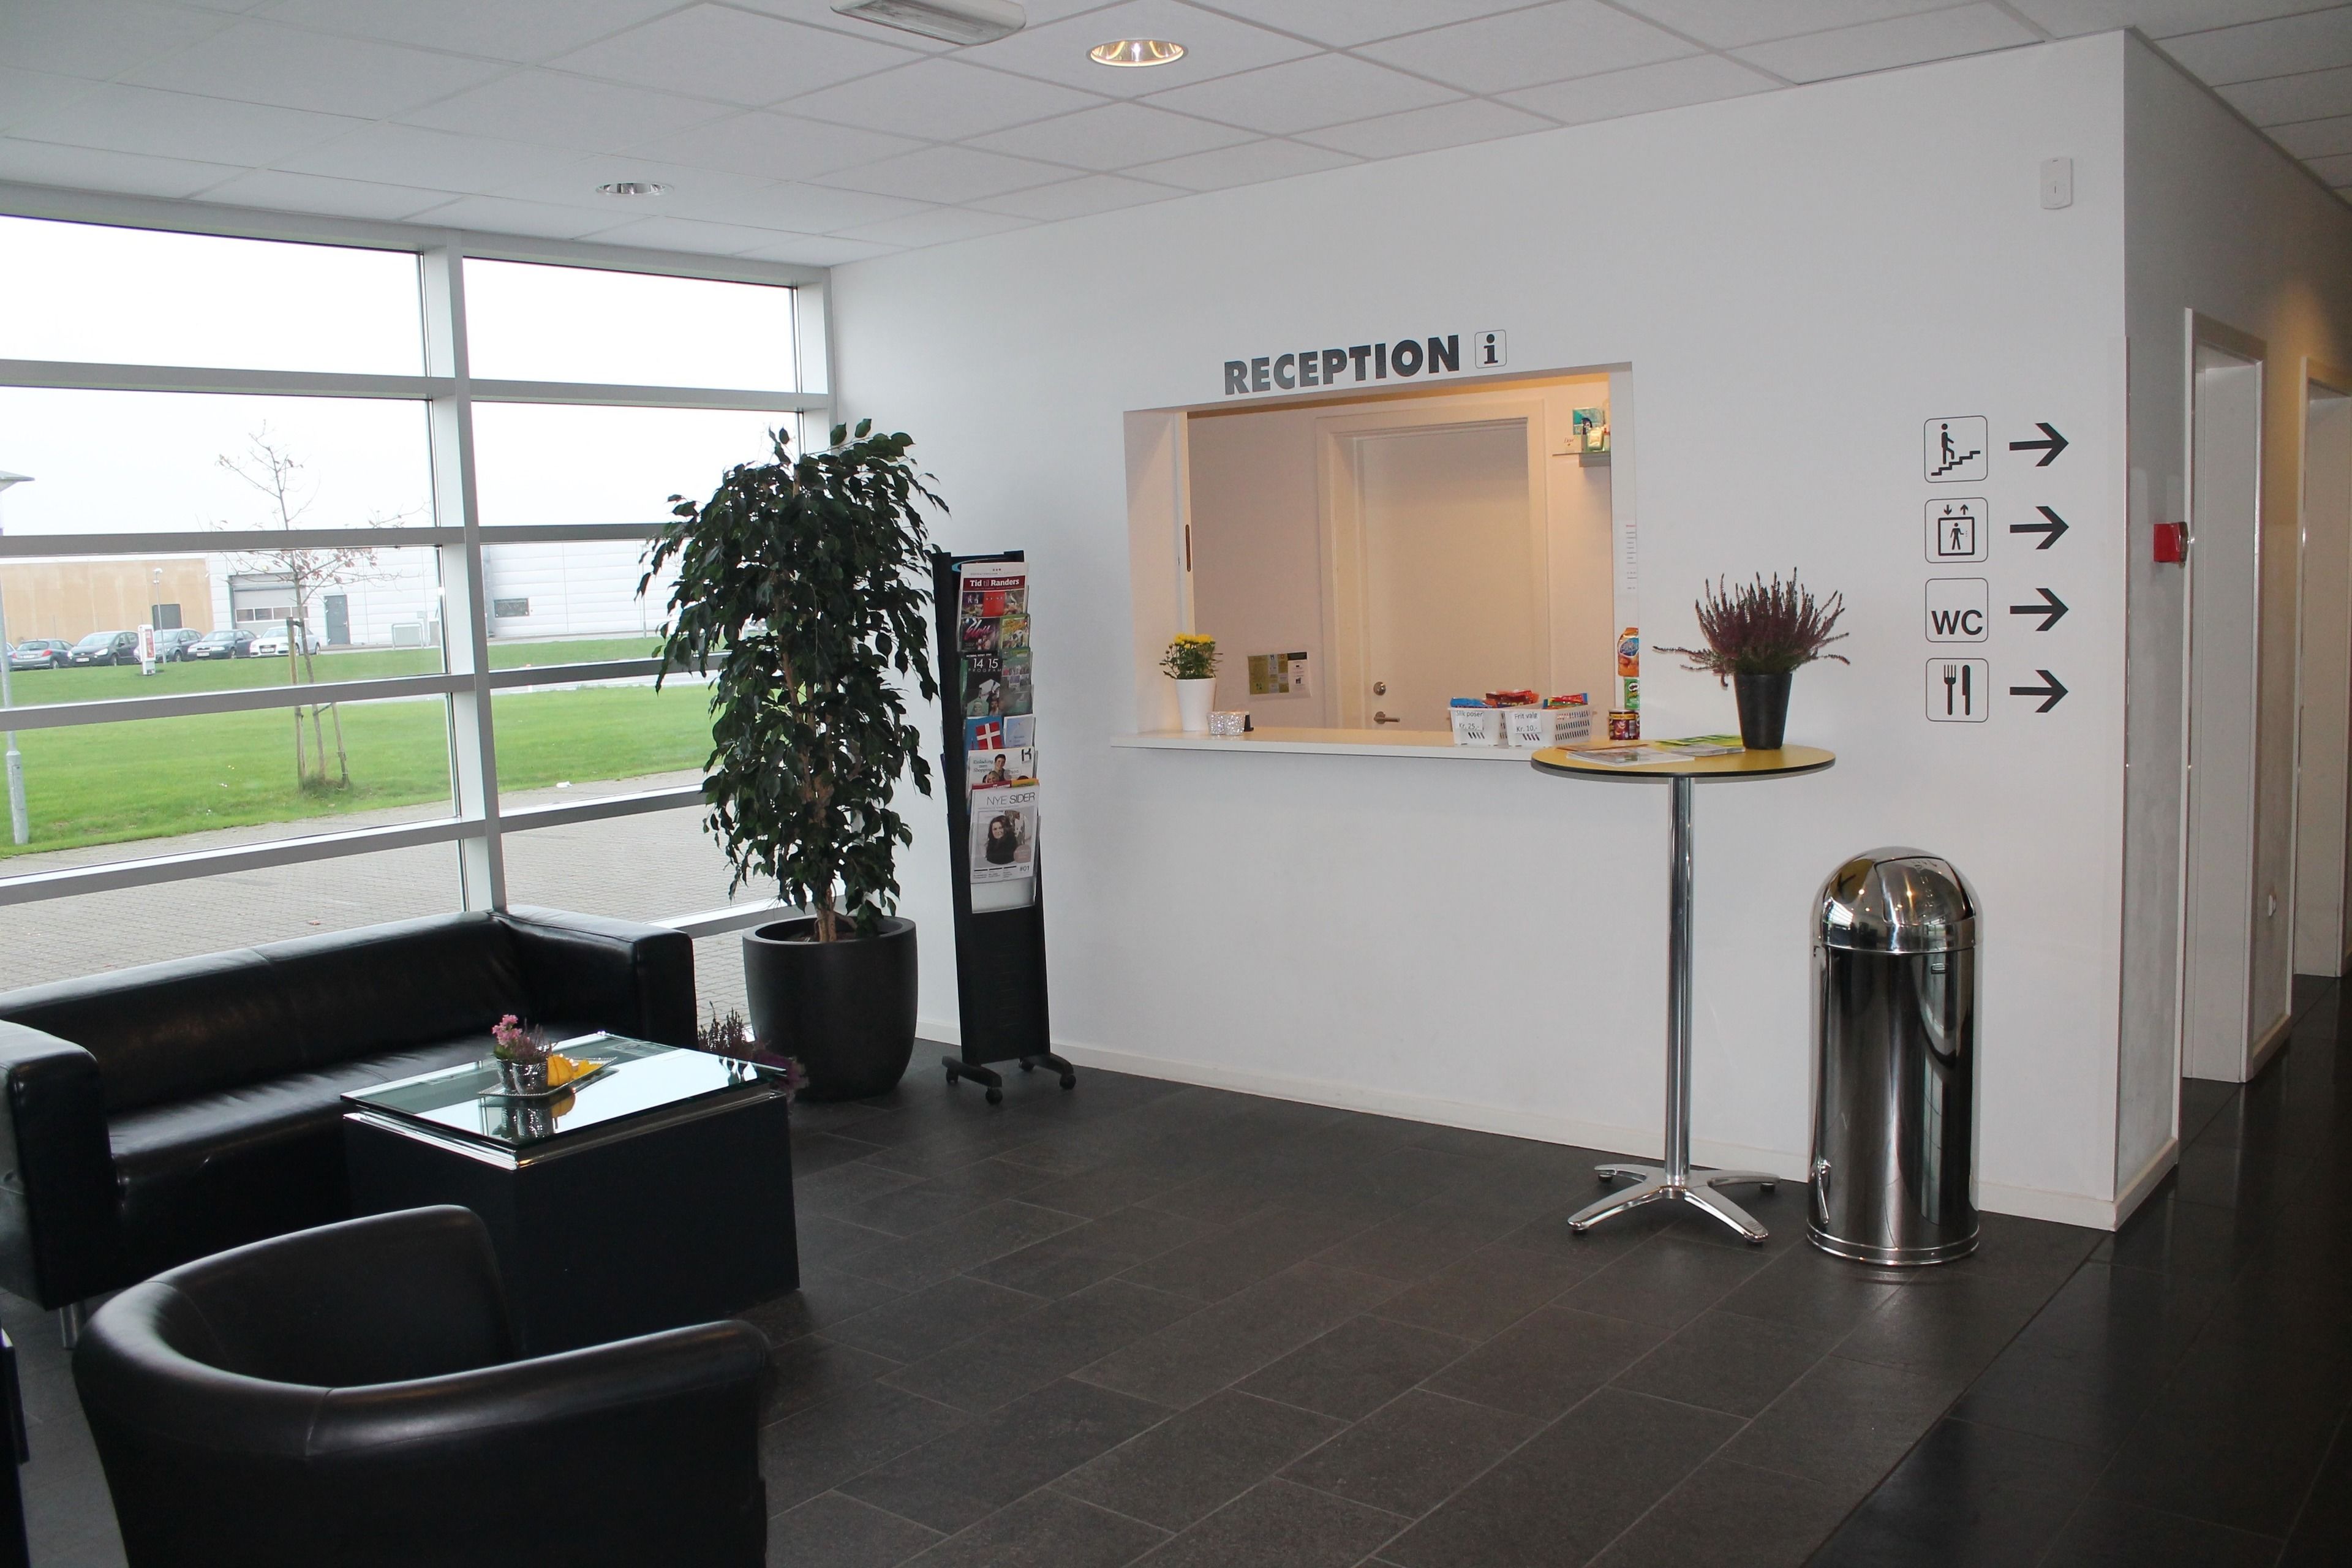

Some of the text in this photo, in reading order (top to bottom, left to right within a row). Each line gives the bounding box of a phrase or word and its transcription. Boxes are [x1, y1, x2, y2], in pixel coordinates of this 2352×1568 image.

[1224, 334, 1460, 395] RECEPTION
[1931, 609, 1983, 635] WC
[973, 658, 999, 668] 14 15
[987, 791, 1036, 805] NYE SIDER
